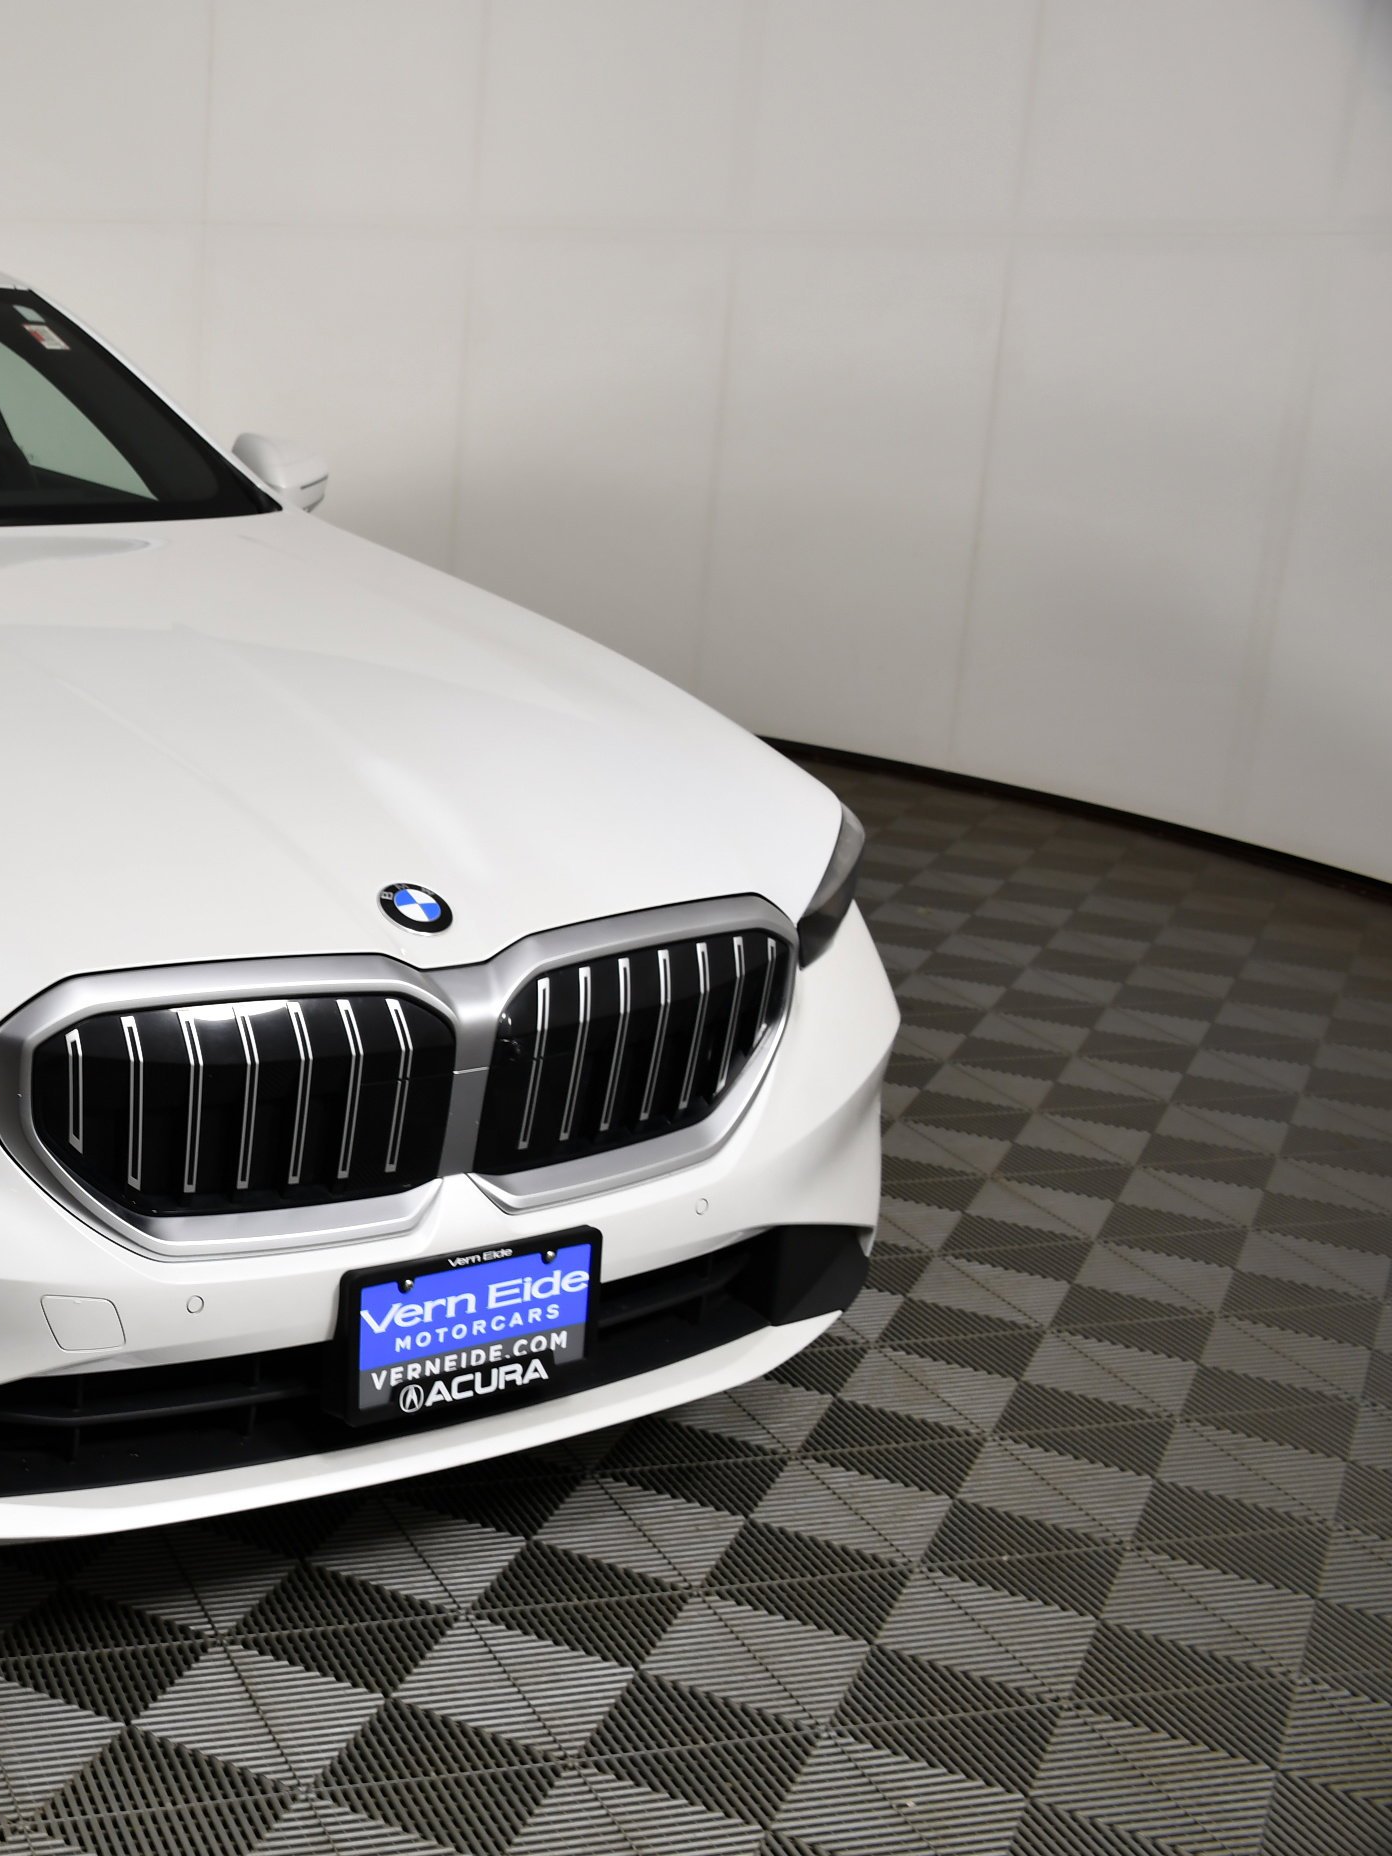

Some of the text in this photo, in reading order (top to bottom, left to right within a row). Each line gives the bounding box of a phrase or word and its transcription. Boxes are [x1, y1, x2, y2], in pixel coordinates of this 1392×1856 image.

[447, 1248, 513, 1268] Vern Eide
[360, 1269, 590, 1334] Vern Eide
[395, 1303, 561, 1353] MOTORCARS
[371, 1330, 568, 1391] VERNEIDE.COM
[424, 1358, 549, 1407] ACURA
